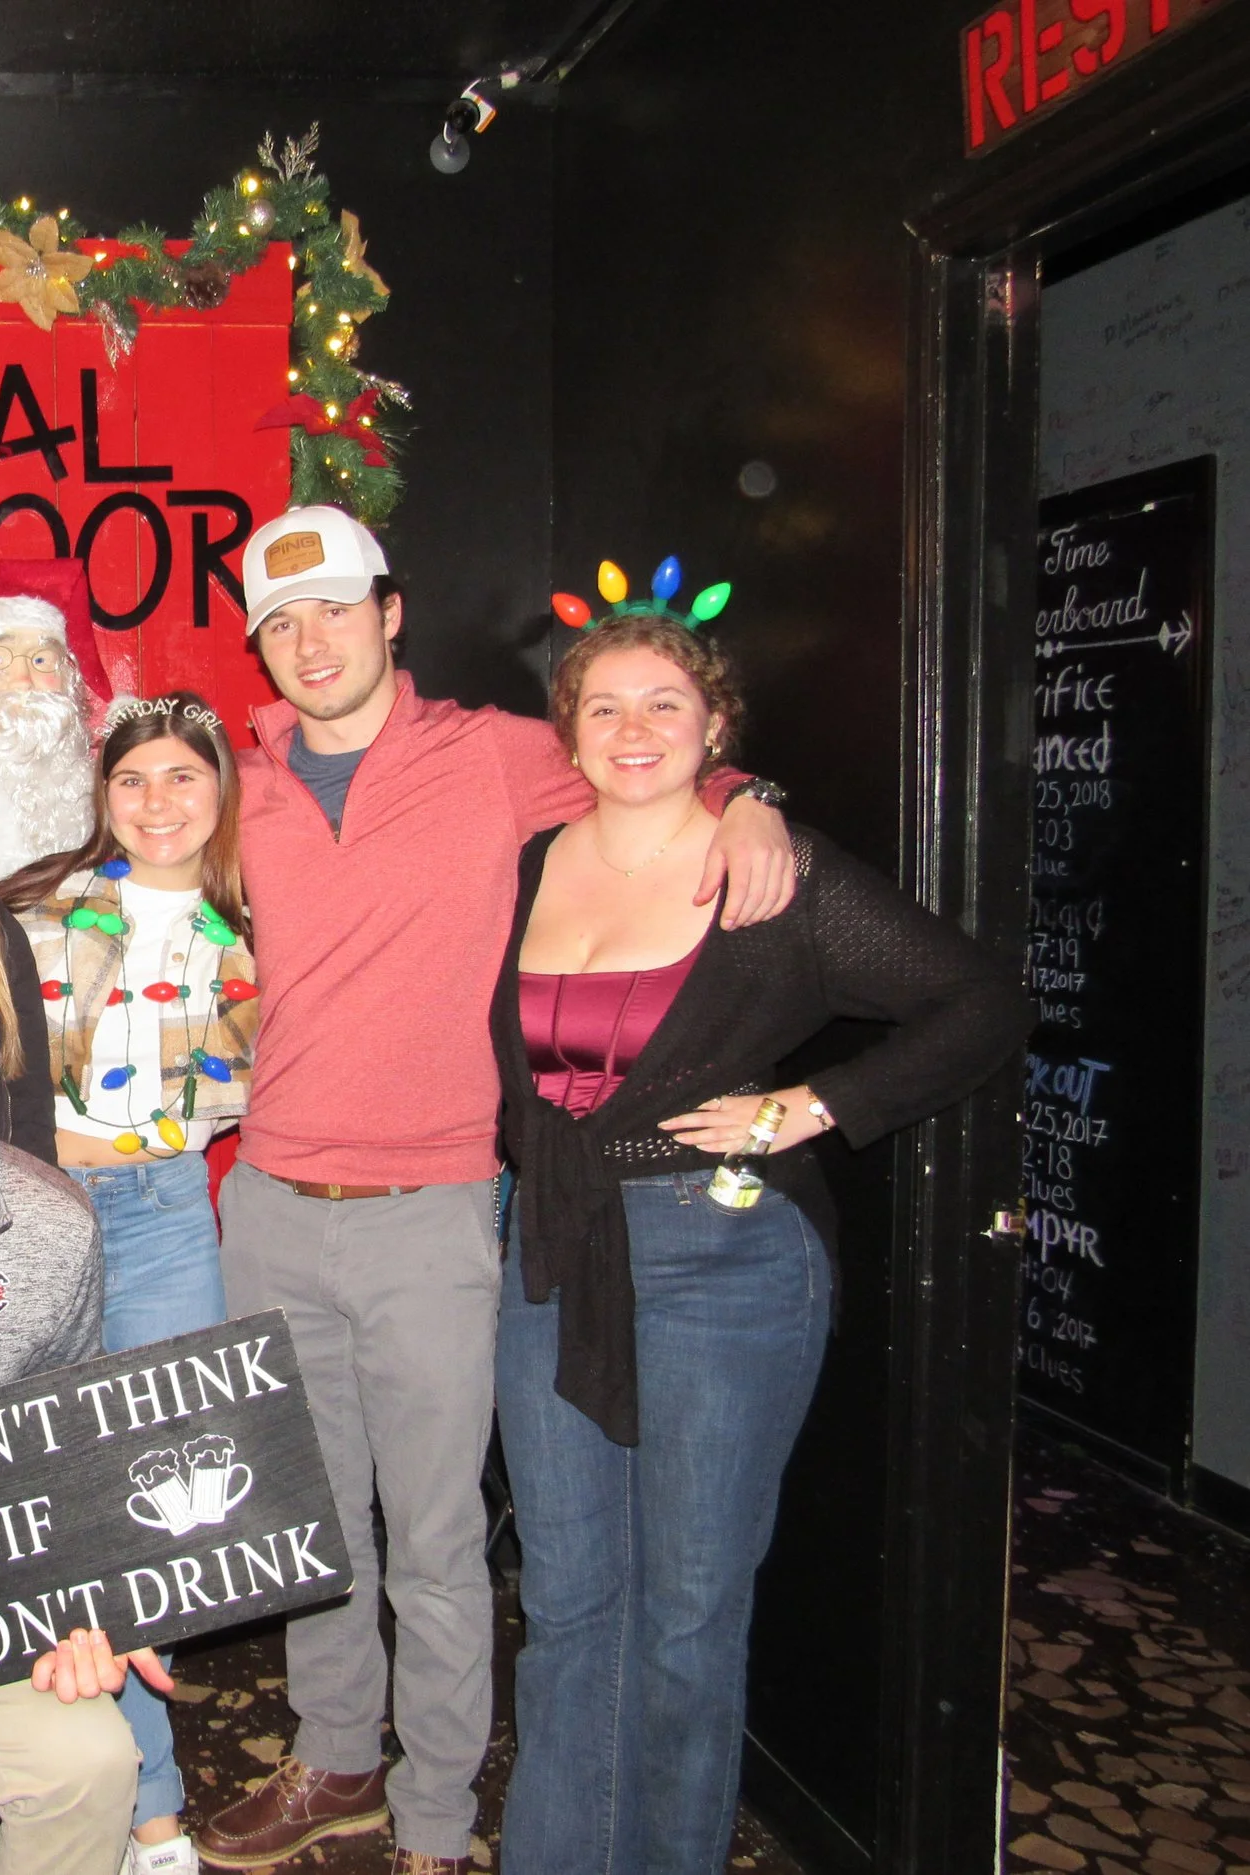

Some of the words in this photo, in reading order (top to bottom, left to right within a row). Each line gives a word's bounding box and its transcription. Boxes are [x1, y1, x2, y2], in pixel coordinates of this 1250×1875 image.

[967, 0, 1171, 149] RES
[269, 536, 316, 560] PING
[1045, 523, 1109, 575] Time
[183, 704, 223, 735] GIRL
[1030, 996, 1082, 1029] lues
[78, 1336, 288, 1440] THINK
[122, 1522, 338, 1627] DRINK
